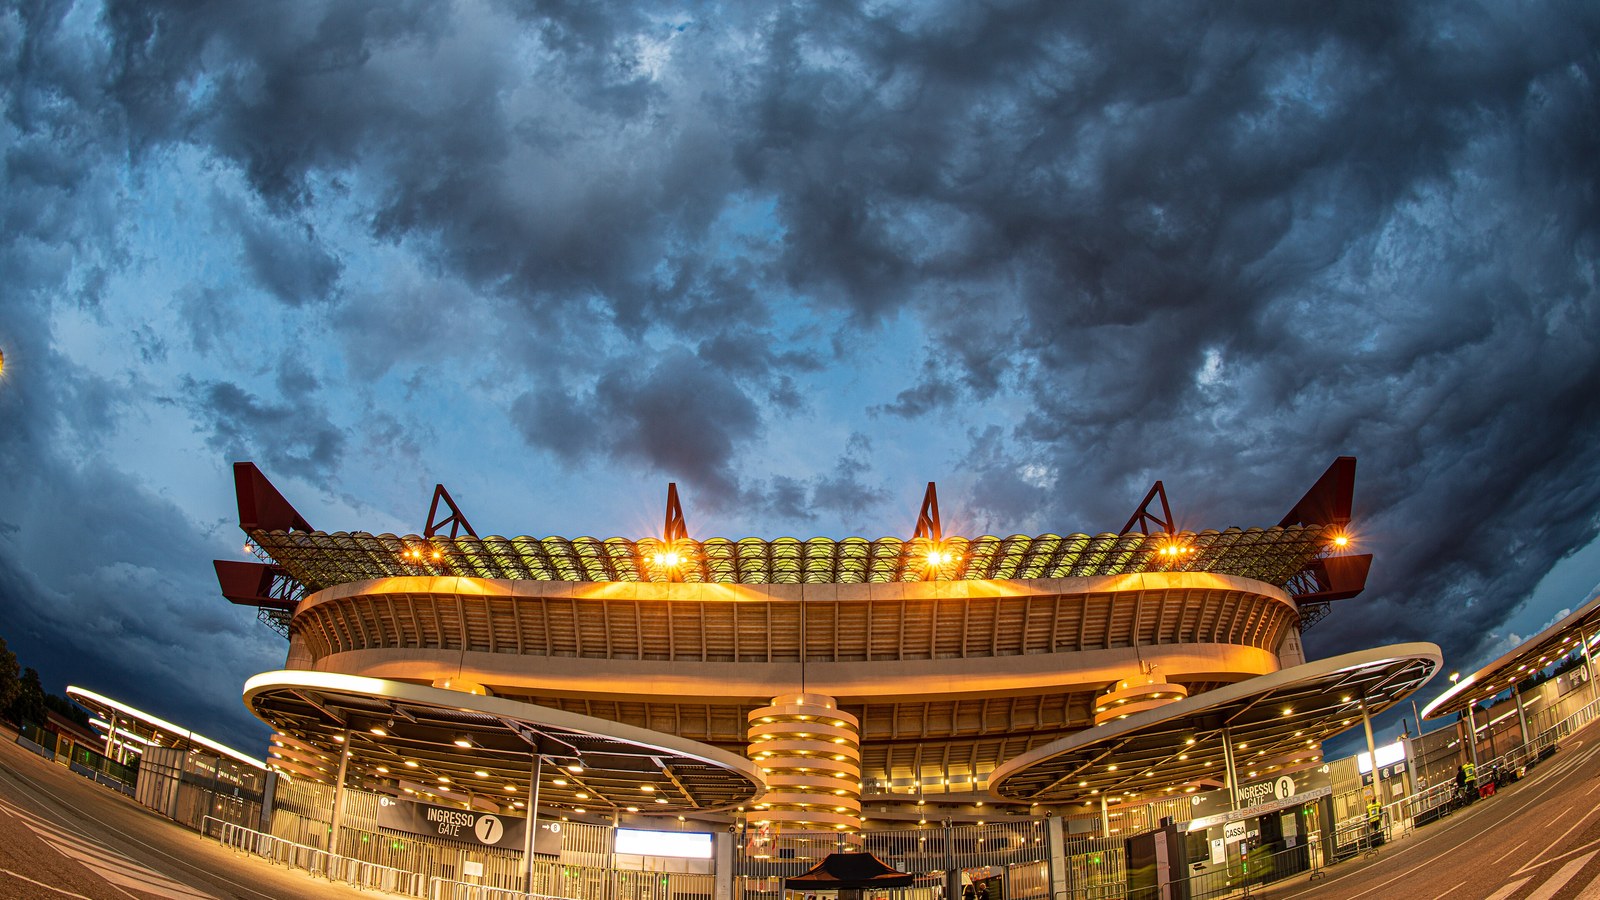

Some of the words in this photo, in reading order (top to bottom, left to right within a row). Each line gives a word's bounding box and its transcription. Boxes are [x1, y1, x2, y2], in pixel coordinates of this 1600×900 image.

[1238, 781, 1273, 801] NGRESSO
[1281, 779, 1289, 798] 8
[1242, 806, 1260, 817] SAN
[1260, 801, 1279, 812] SIRO
[1279, 792, 1311, 807] STADIUM
[1311, 788, 1331, 798] TOUR
[427, 807, 475, 828] INGRESSO
[438, 822, 461, 837] GATE
[484, 818, 495, 840] 7
[1225, 826, 1246, 839] CASSA
